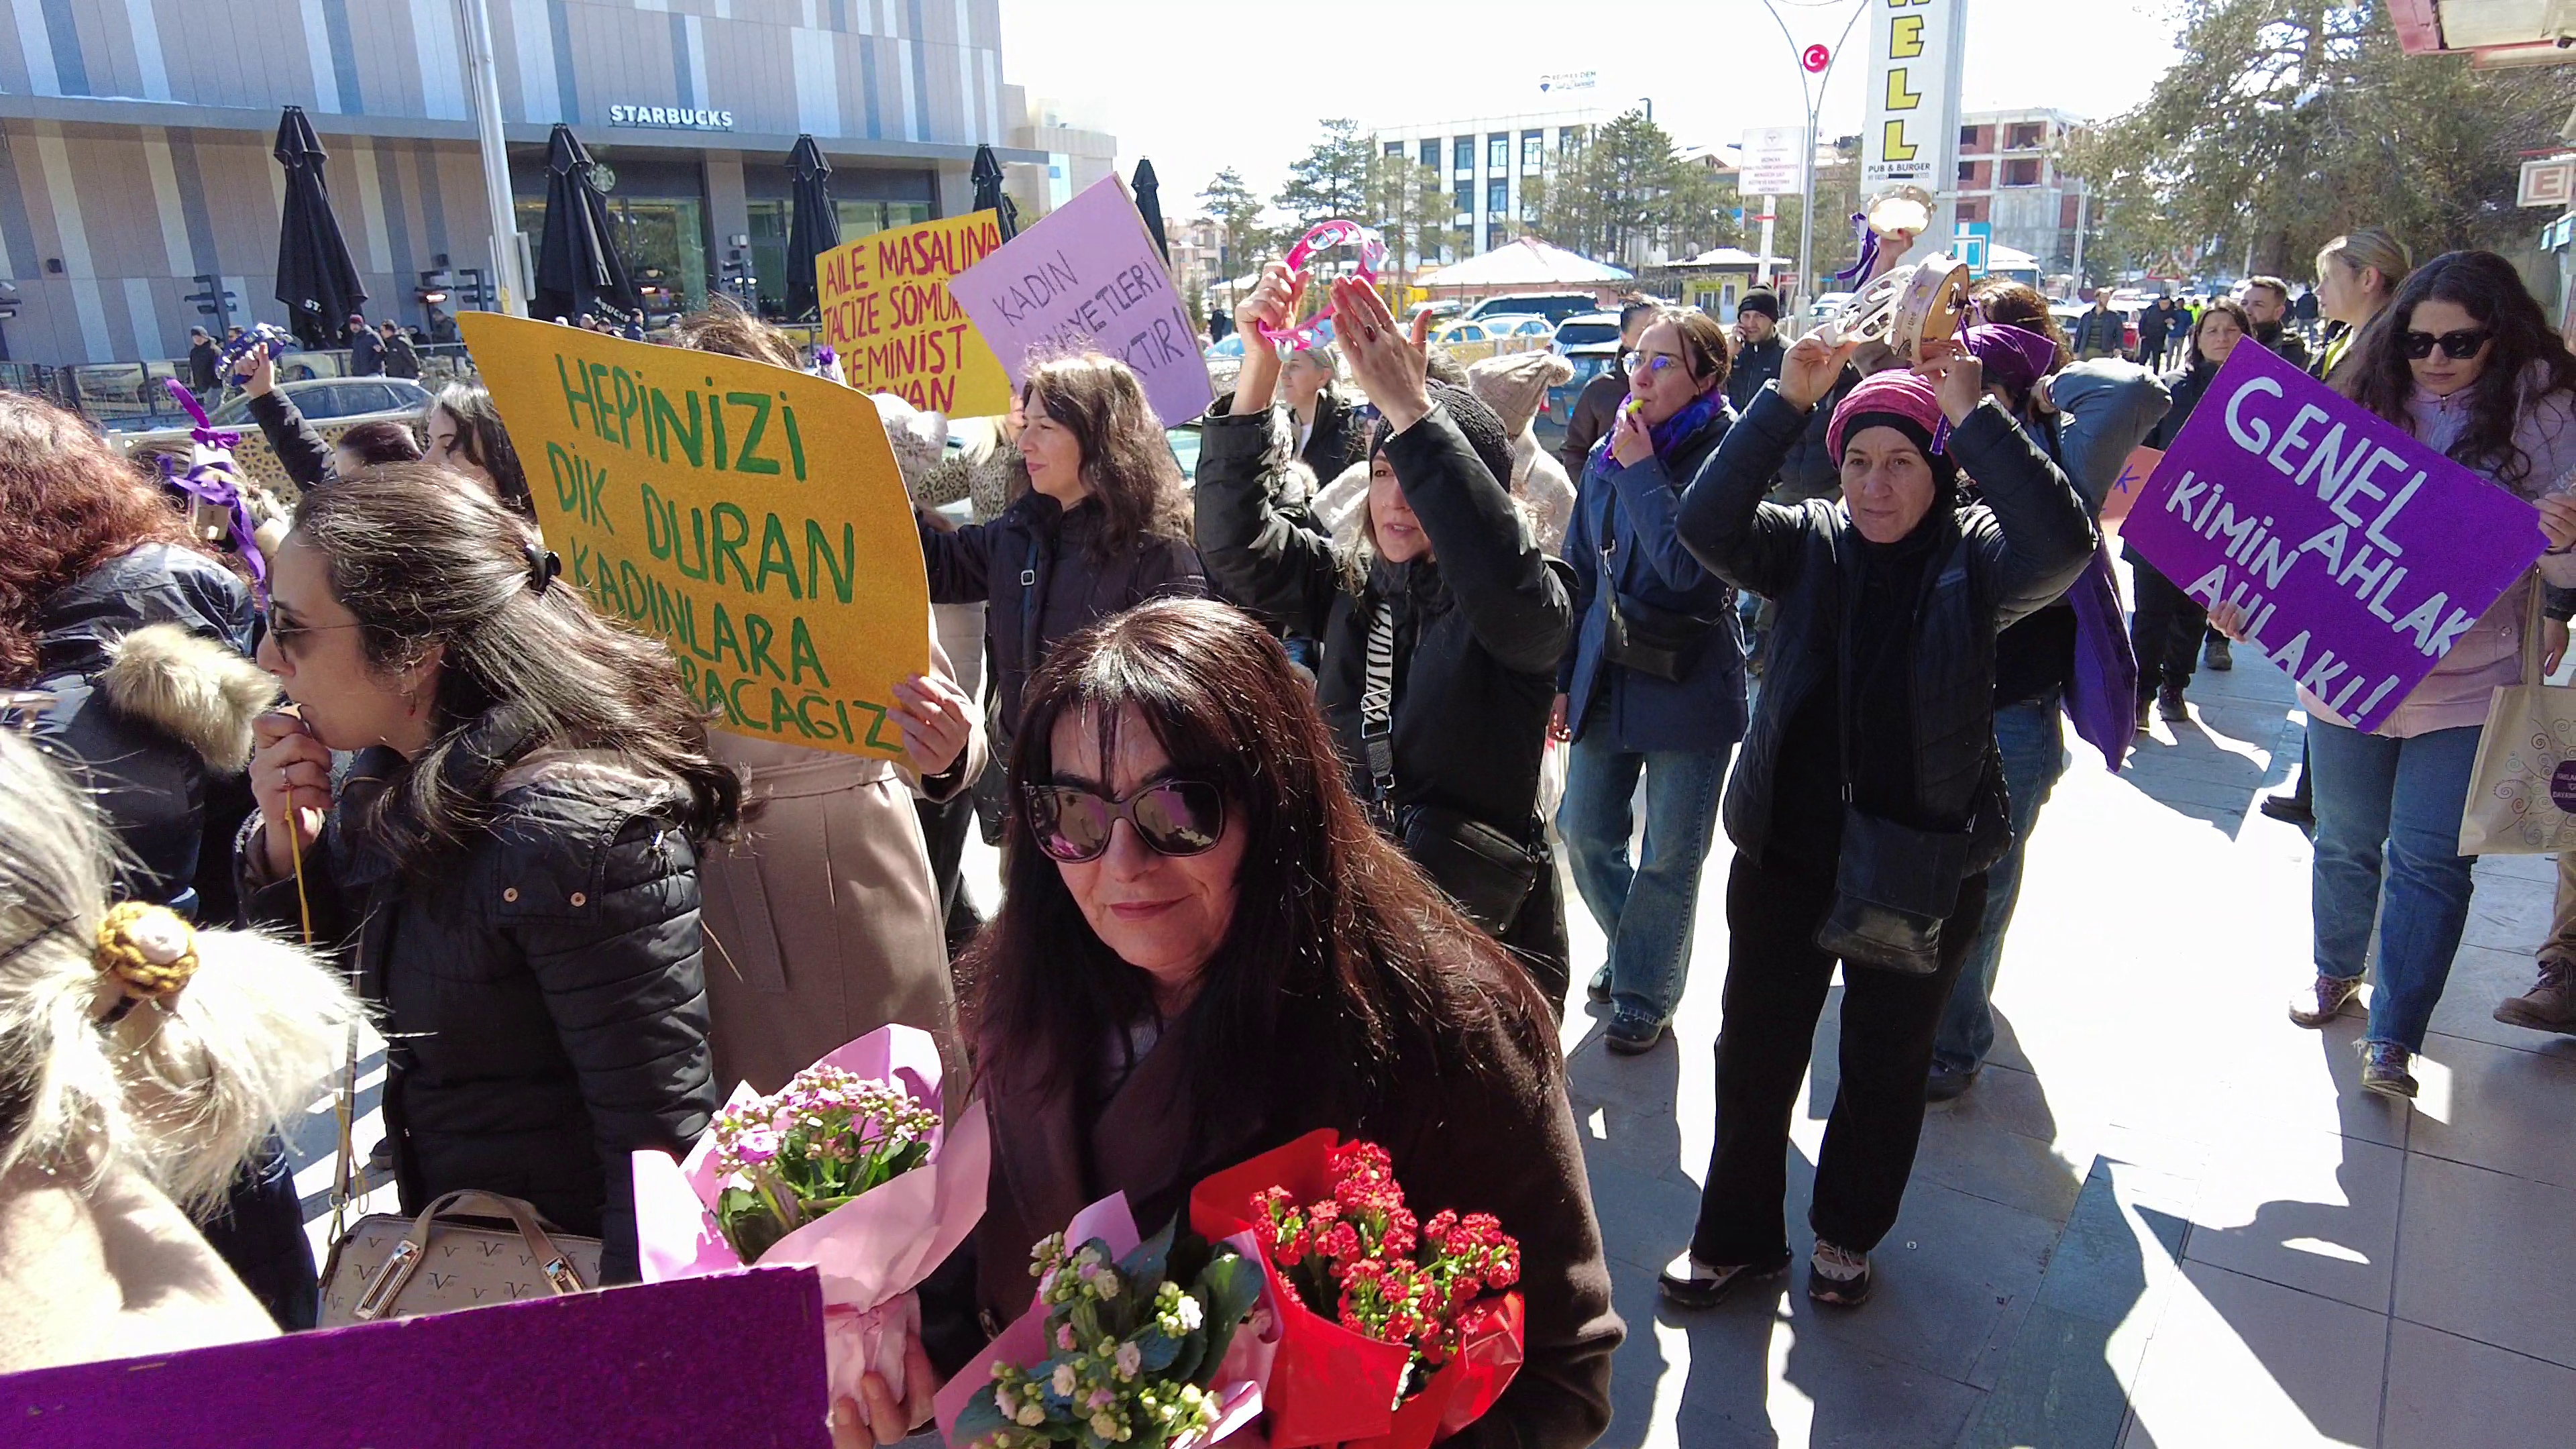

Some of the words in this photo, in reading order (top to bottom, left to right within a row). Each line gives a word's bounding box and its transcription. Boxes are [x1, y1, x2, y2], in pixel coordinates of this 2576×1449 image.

[610, 105, 733, 127] STARBUCKS
[1882, 0, 1931, 162] ELL
[1868, 165, 1885, 173] PUB
[1888, 164, 1894, 172] &
[1896, 162, 1931, 172] BURGER
[991, 249, 1079, 327] KADIN
[555, 354, 807, 482] HEPİNİZİ
[2224, 376, 2427, 558] GENEL
[641, 482, 854, 603] DURAN
[2165, 470, 2300, 591] KİMİN
[2299, 522, 2477, 659] AHLAK
[572, 537, 830, 688] KADINLARA
[680, 655, 903, 753] RACAĞIZ
